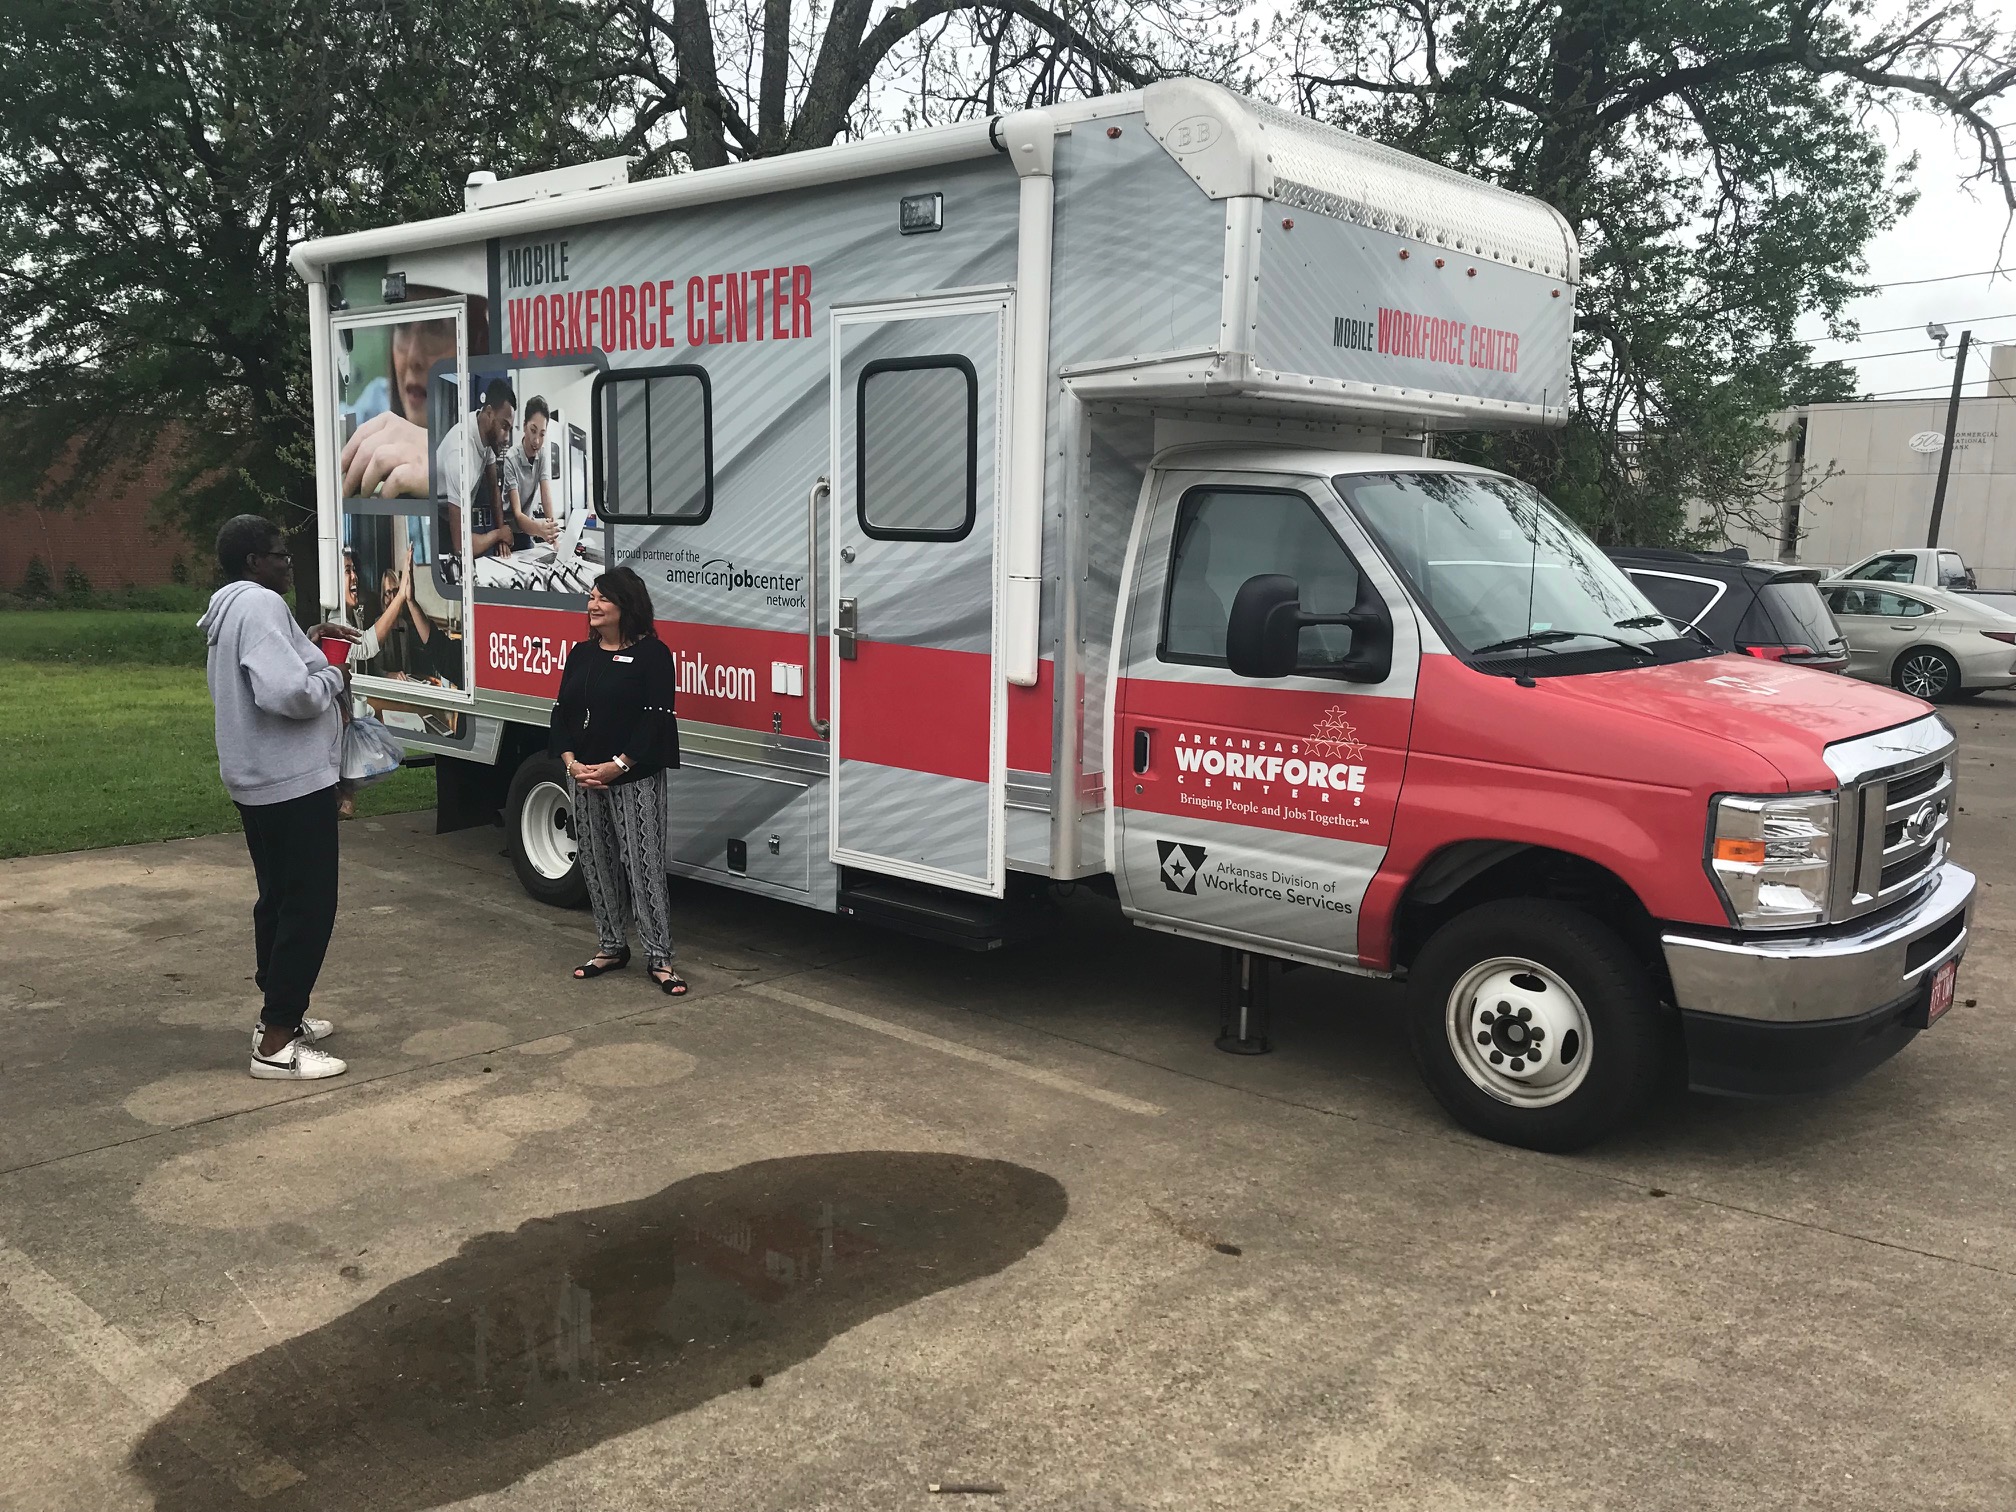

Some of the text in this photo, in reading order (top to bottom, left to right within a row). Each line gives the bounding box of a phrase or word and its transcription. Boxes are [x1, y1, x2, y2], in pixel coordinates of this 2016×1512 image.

[508, 241, 569, 288] MOBILE
[508, 265, 812, 359] WORKFORCE CENTER
[1333, 307, 1519, 374] MOBILE WORKFORCE CENTER
[616, 548, 641, 561] proud
[642, 549, 674, 562] partner
[675, 549, 684, 561] of
[685, 550, 700, 562] the
[766, 595, 806, 608] network
[1178, 733, 1299, 754] ARKANSAS
[1174, 746, 1367, 793] WORKFORCE
[1177, 775, 1361, 807] CENTERS
[1180, 792, 1223, 811] Bringing
[1225, 798, 1259, 815] People
[1261, 805, 1280, 816] and
[1282, 806, 1307, 820] Jobs
[1307, 809, 1359, 828] Together.
[1202, 873, 1353, 915] Workforce Services
[1216, 862, 1337, 894] Arkansas Division of
